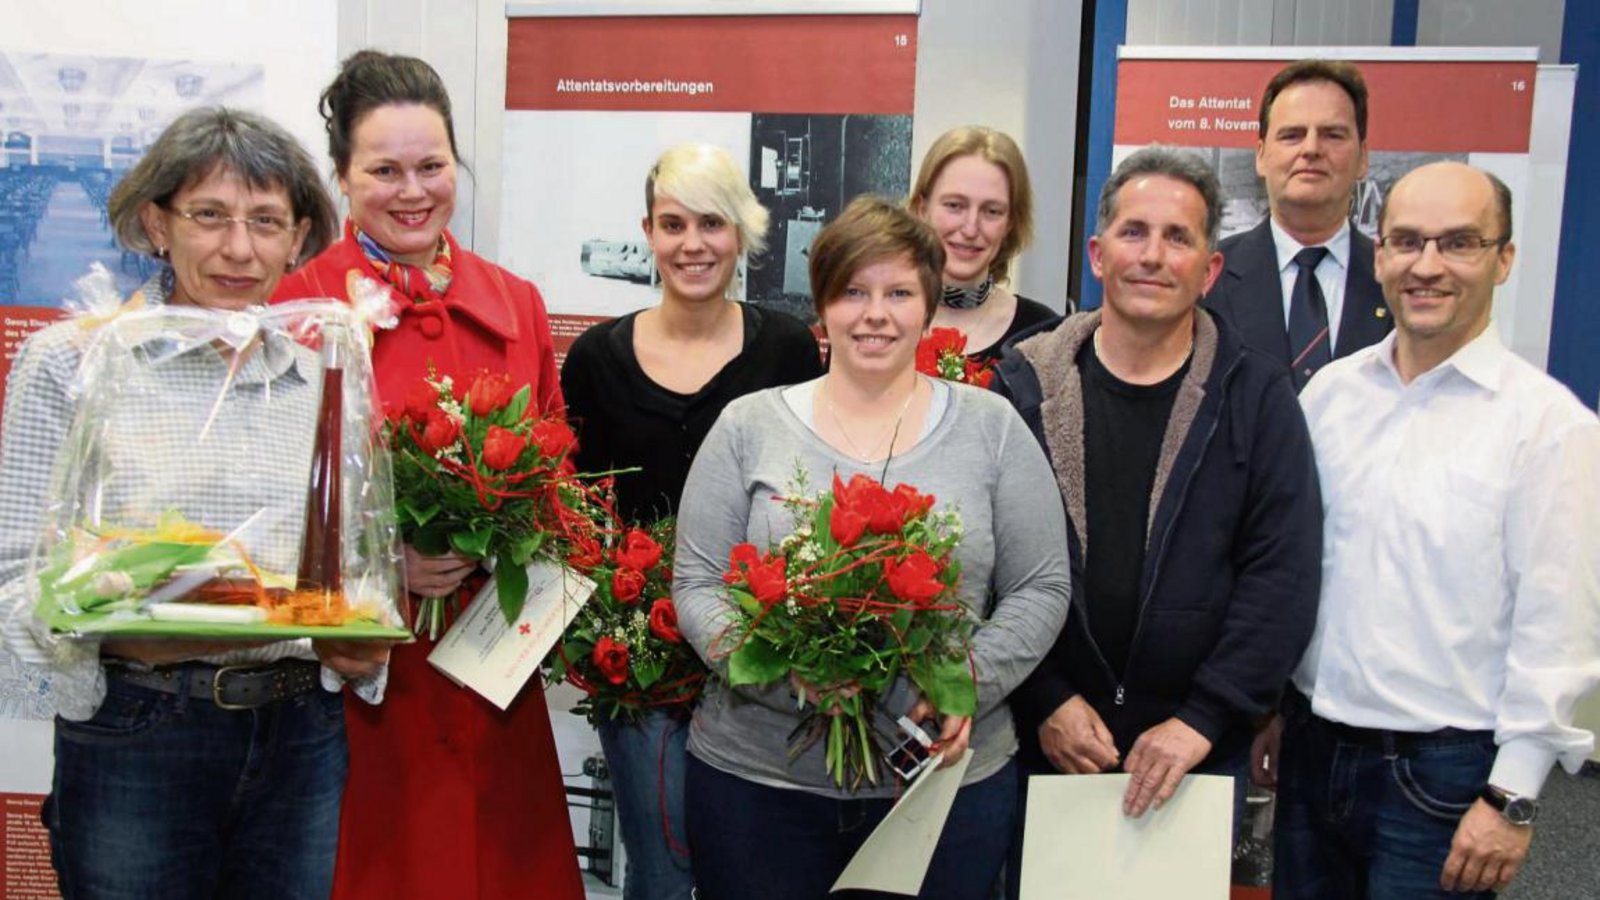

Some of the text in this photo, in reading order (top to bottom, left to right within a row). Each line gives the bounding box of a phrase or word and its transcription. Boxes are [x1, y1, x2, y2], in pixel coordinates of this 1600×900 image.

[894, 34, 907, 46] 15
[556, 79, 714, 95] Attentatsvorbereitungen
[1511, 81, 1525, 92] 16
[1169, 96, 1252, 110] Das Attentat
[1168, 118, 1195, 130] vom
[1199, 117, 1211, 130] 8.
